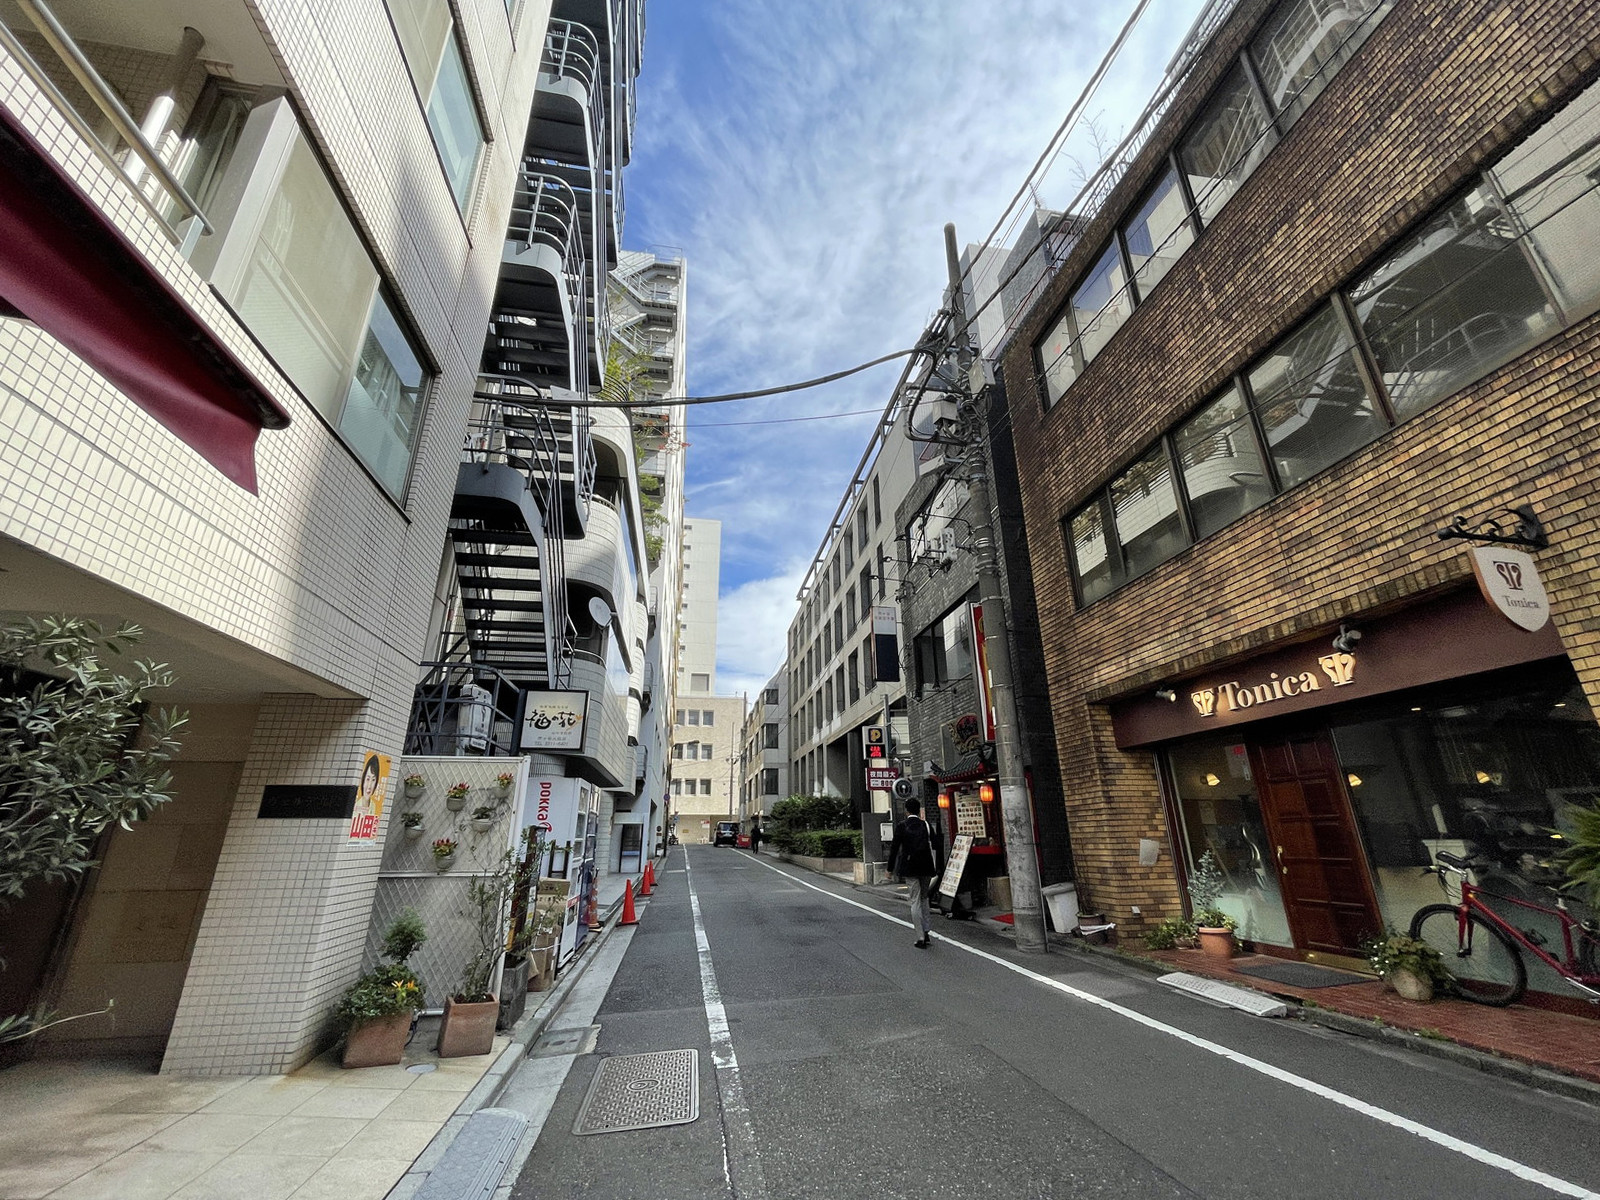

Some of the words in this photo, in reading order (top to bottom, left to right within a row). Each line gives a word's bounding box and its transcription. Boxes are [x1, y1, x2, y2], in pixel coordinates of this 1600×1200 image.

[1502, 595, 1541, 608] Tonica
[1218, 671, 1323, 711] Tonica
[525, 709, 576, 730] 福の花
[870, 729, 882, 742] P
[350, 813, 374, 837] 山田
